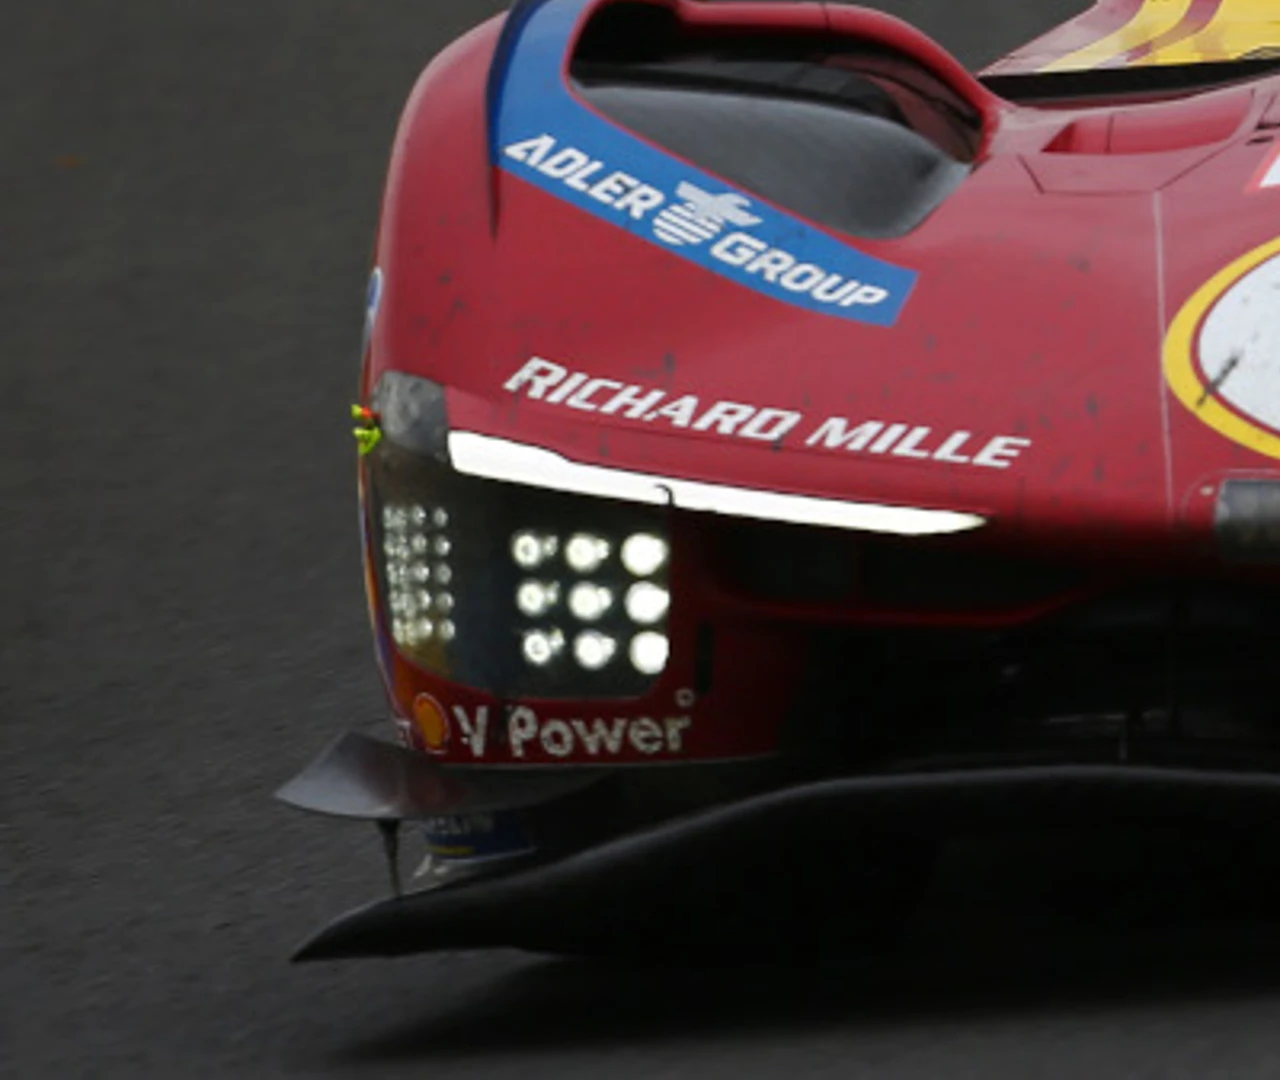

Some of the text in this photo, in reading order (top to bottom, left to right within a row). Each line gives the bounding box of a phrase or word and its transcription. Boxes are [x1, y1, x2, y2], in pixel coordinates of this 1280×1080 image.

[504, 133, 889, 311] ADLER GROUP
[505, 357, 1031, 469] RICHARD MILLE
